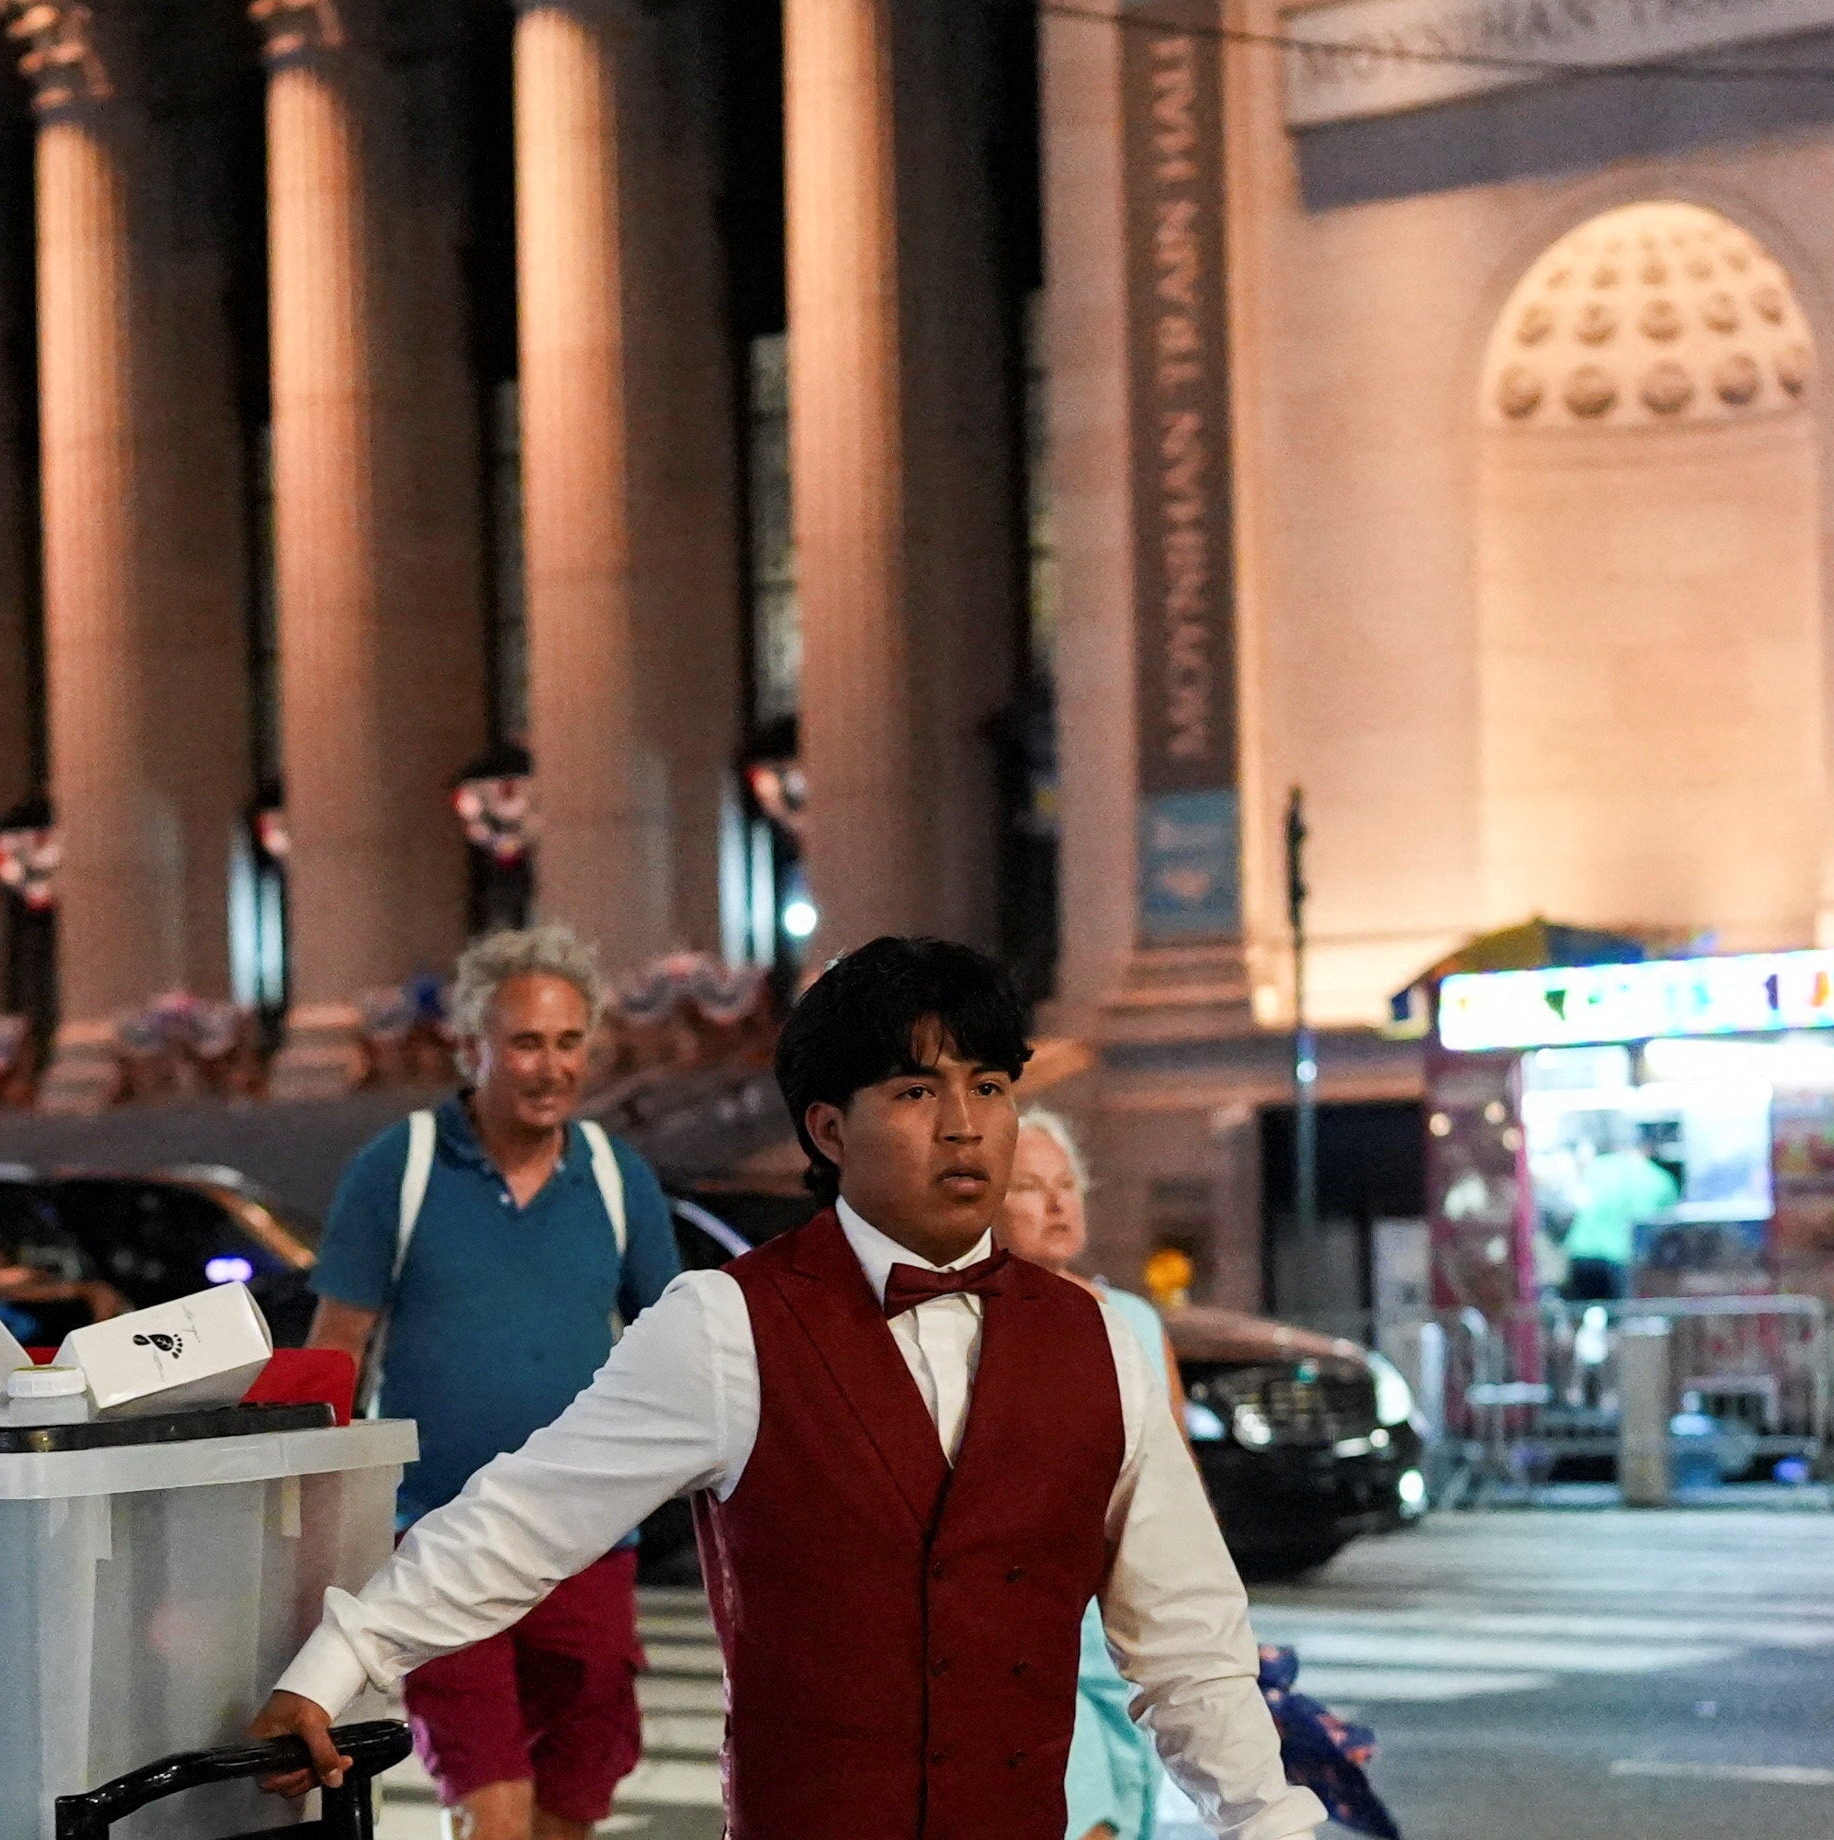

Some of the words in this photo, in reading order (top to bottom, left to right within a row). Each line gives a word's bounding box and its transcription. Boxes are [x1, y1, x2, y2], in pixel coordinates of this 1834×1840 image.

[1149, 34, 1201, 183] HALL
[1153, 197, 1204, 380] TRAIN
[1162, 406, 1212, 762] MOYNIHAN
